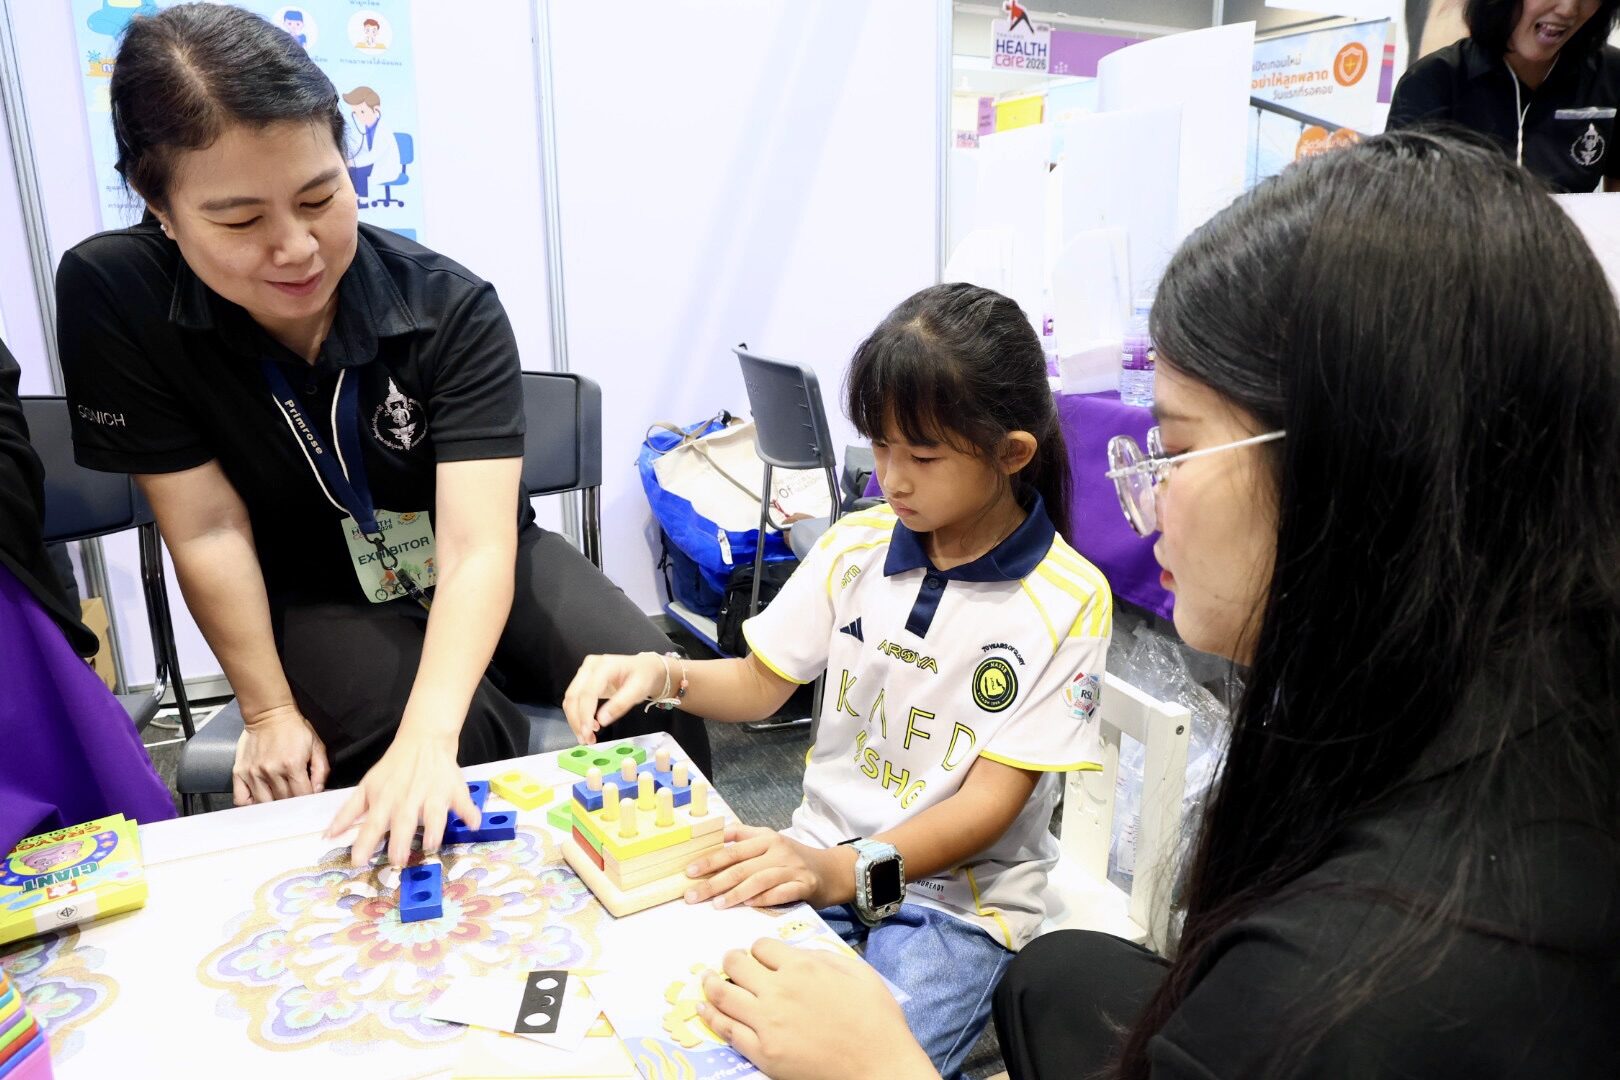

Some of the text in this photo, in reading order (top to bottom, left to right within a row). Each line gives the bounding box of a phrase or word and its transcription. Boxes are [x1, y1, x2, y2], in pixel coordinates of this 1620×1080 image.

[996, 39, 1047, 57] HEALTH
[1026, 57, 1046, 70] 2026
[284, 399, 323, 455] Primrose
[352, 518, 393, 536] HTH
[989, 642, 1008, 650] YEARS
[877, 639, 938, 674] AROYA
[21, 861, 99, 894] GIANT
